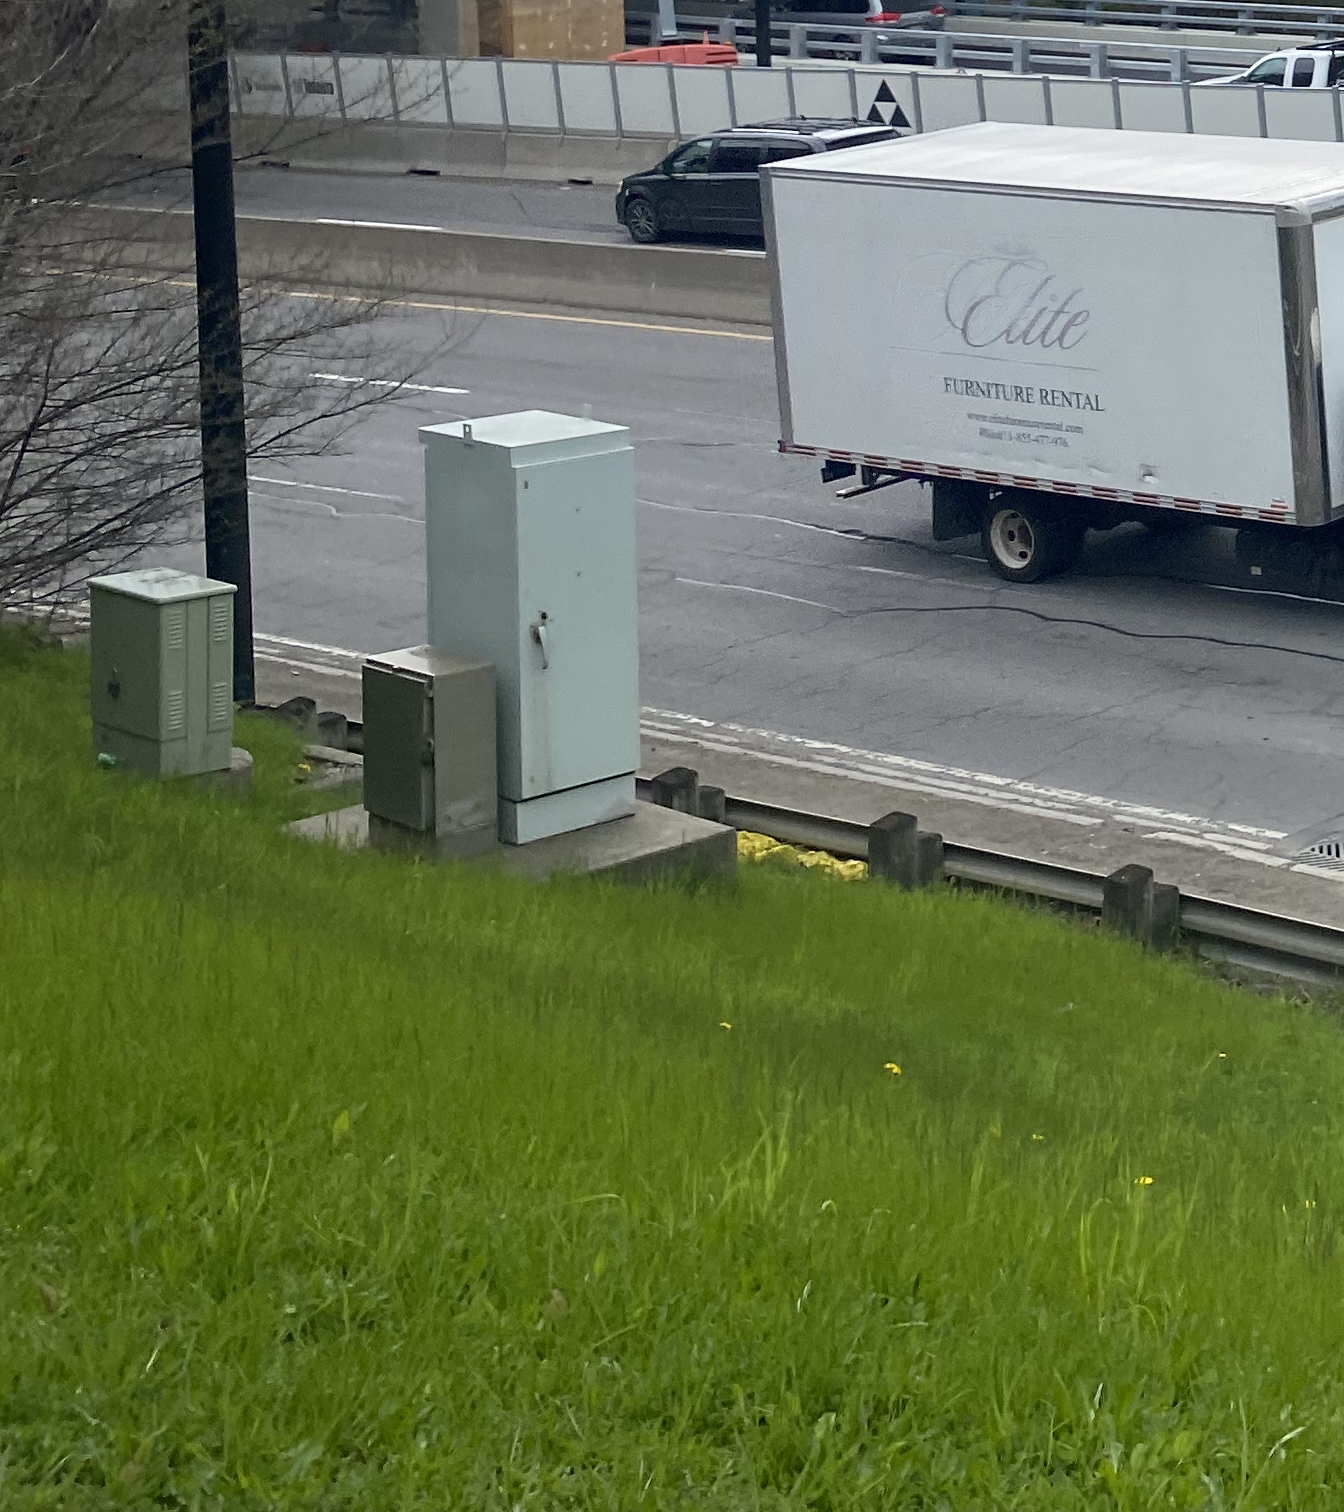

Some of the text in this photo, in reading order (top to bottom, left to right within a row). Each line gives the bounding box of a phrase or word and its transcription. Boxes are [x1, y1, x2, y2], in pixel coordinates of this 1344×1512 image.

[944, 256, 1090, 350] Elite
[943, 376, 1106, 412] FURNITURE RENTAL
